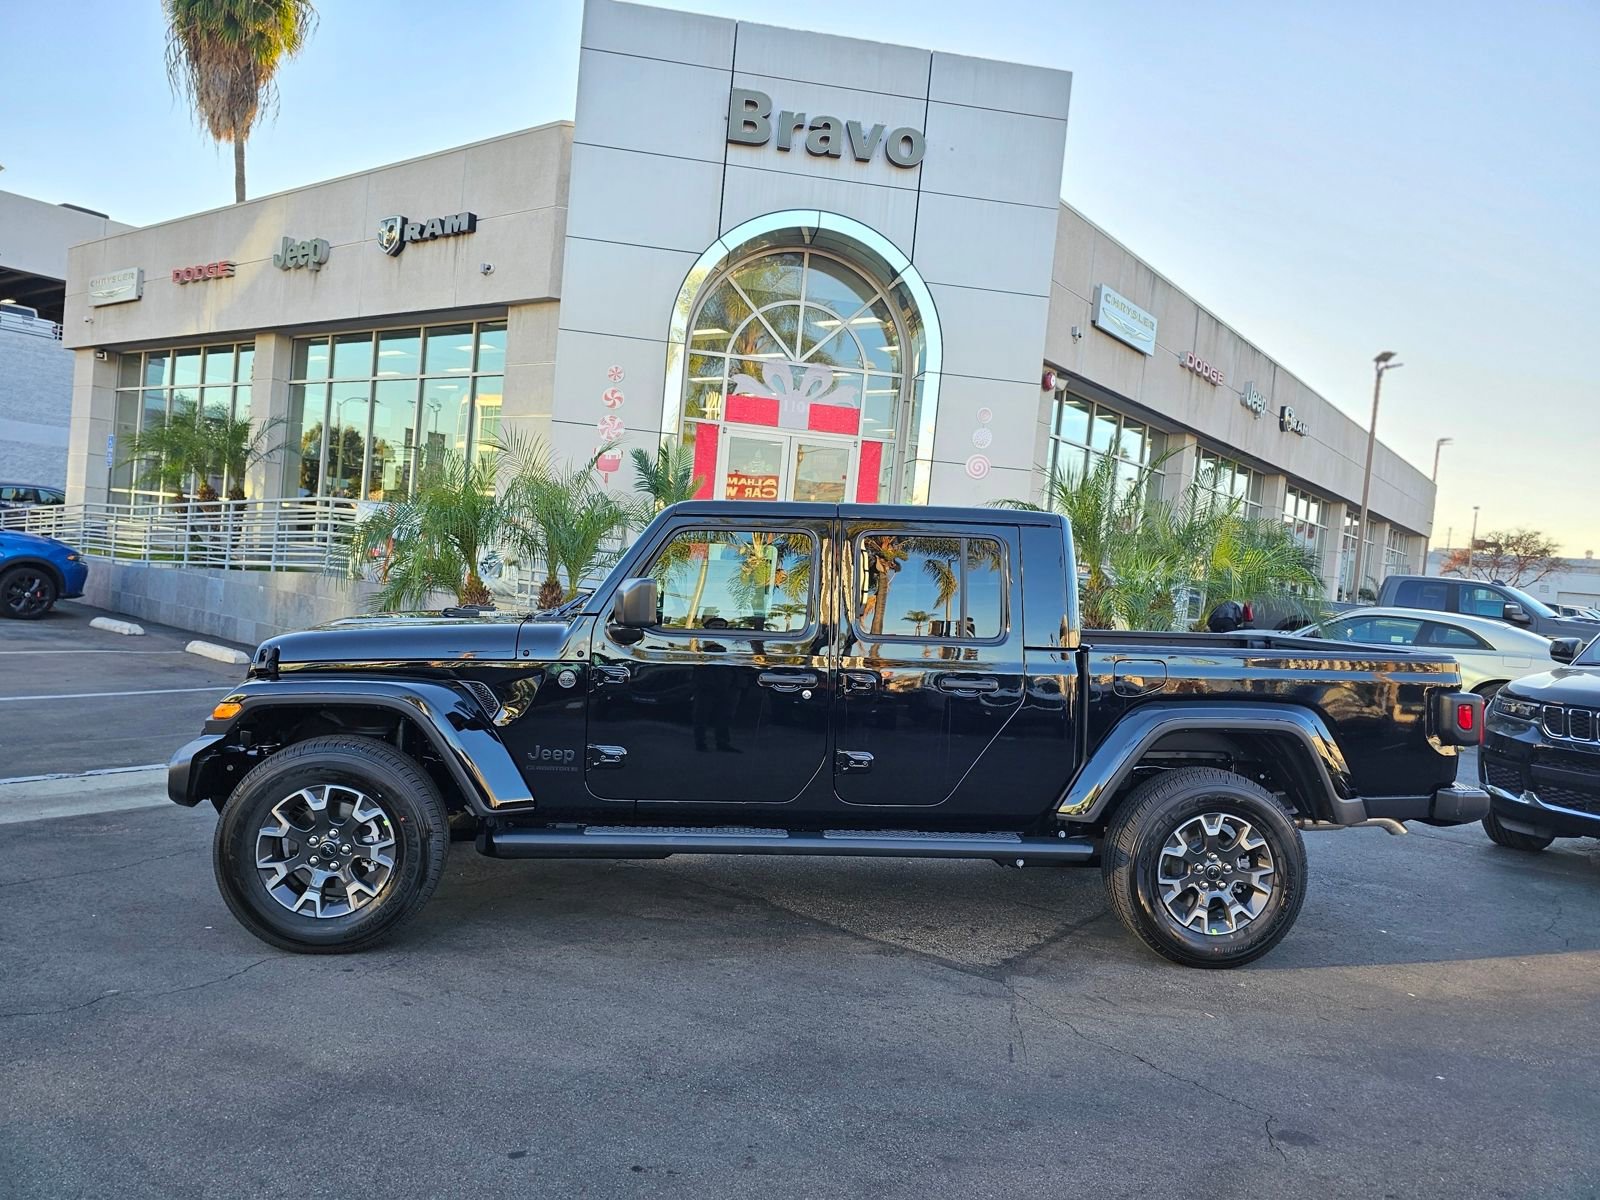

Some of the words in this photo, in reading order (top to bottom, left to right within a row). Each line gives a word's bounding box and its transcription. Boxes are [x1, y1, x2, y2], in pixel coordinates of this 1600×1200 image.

[727, 87, 926, 169] Bravo
[404, 212, 476, 243] RAM
[273, 236, 328, 272] Jeep
[90, 271, 136, 288] CHRYSLER
[172, 260, 233, 284] DODGE
[1104, 292, 1156, 332] CHRYSLER
[1186, 352, 1225, 386] DODGE
[1245, 382, 1267, 417] Jeep
[1292, 417, 1309, 436] RAM
[528, 745, 575, 764] Jeep
